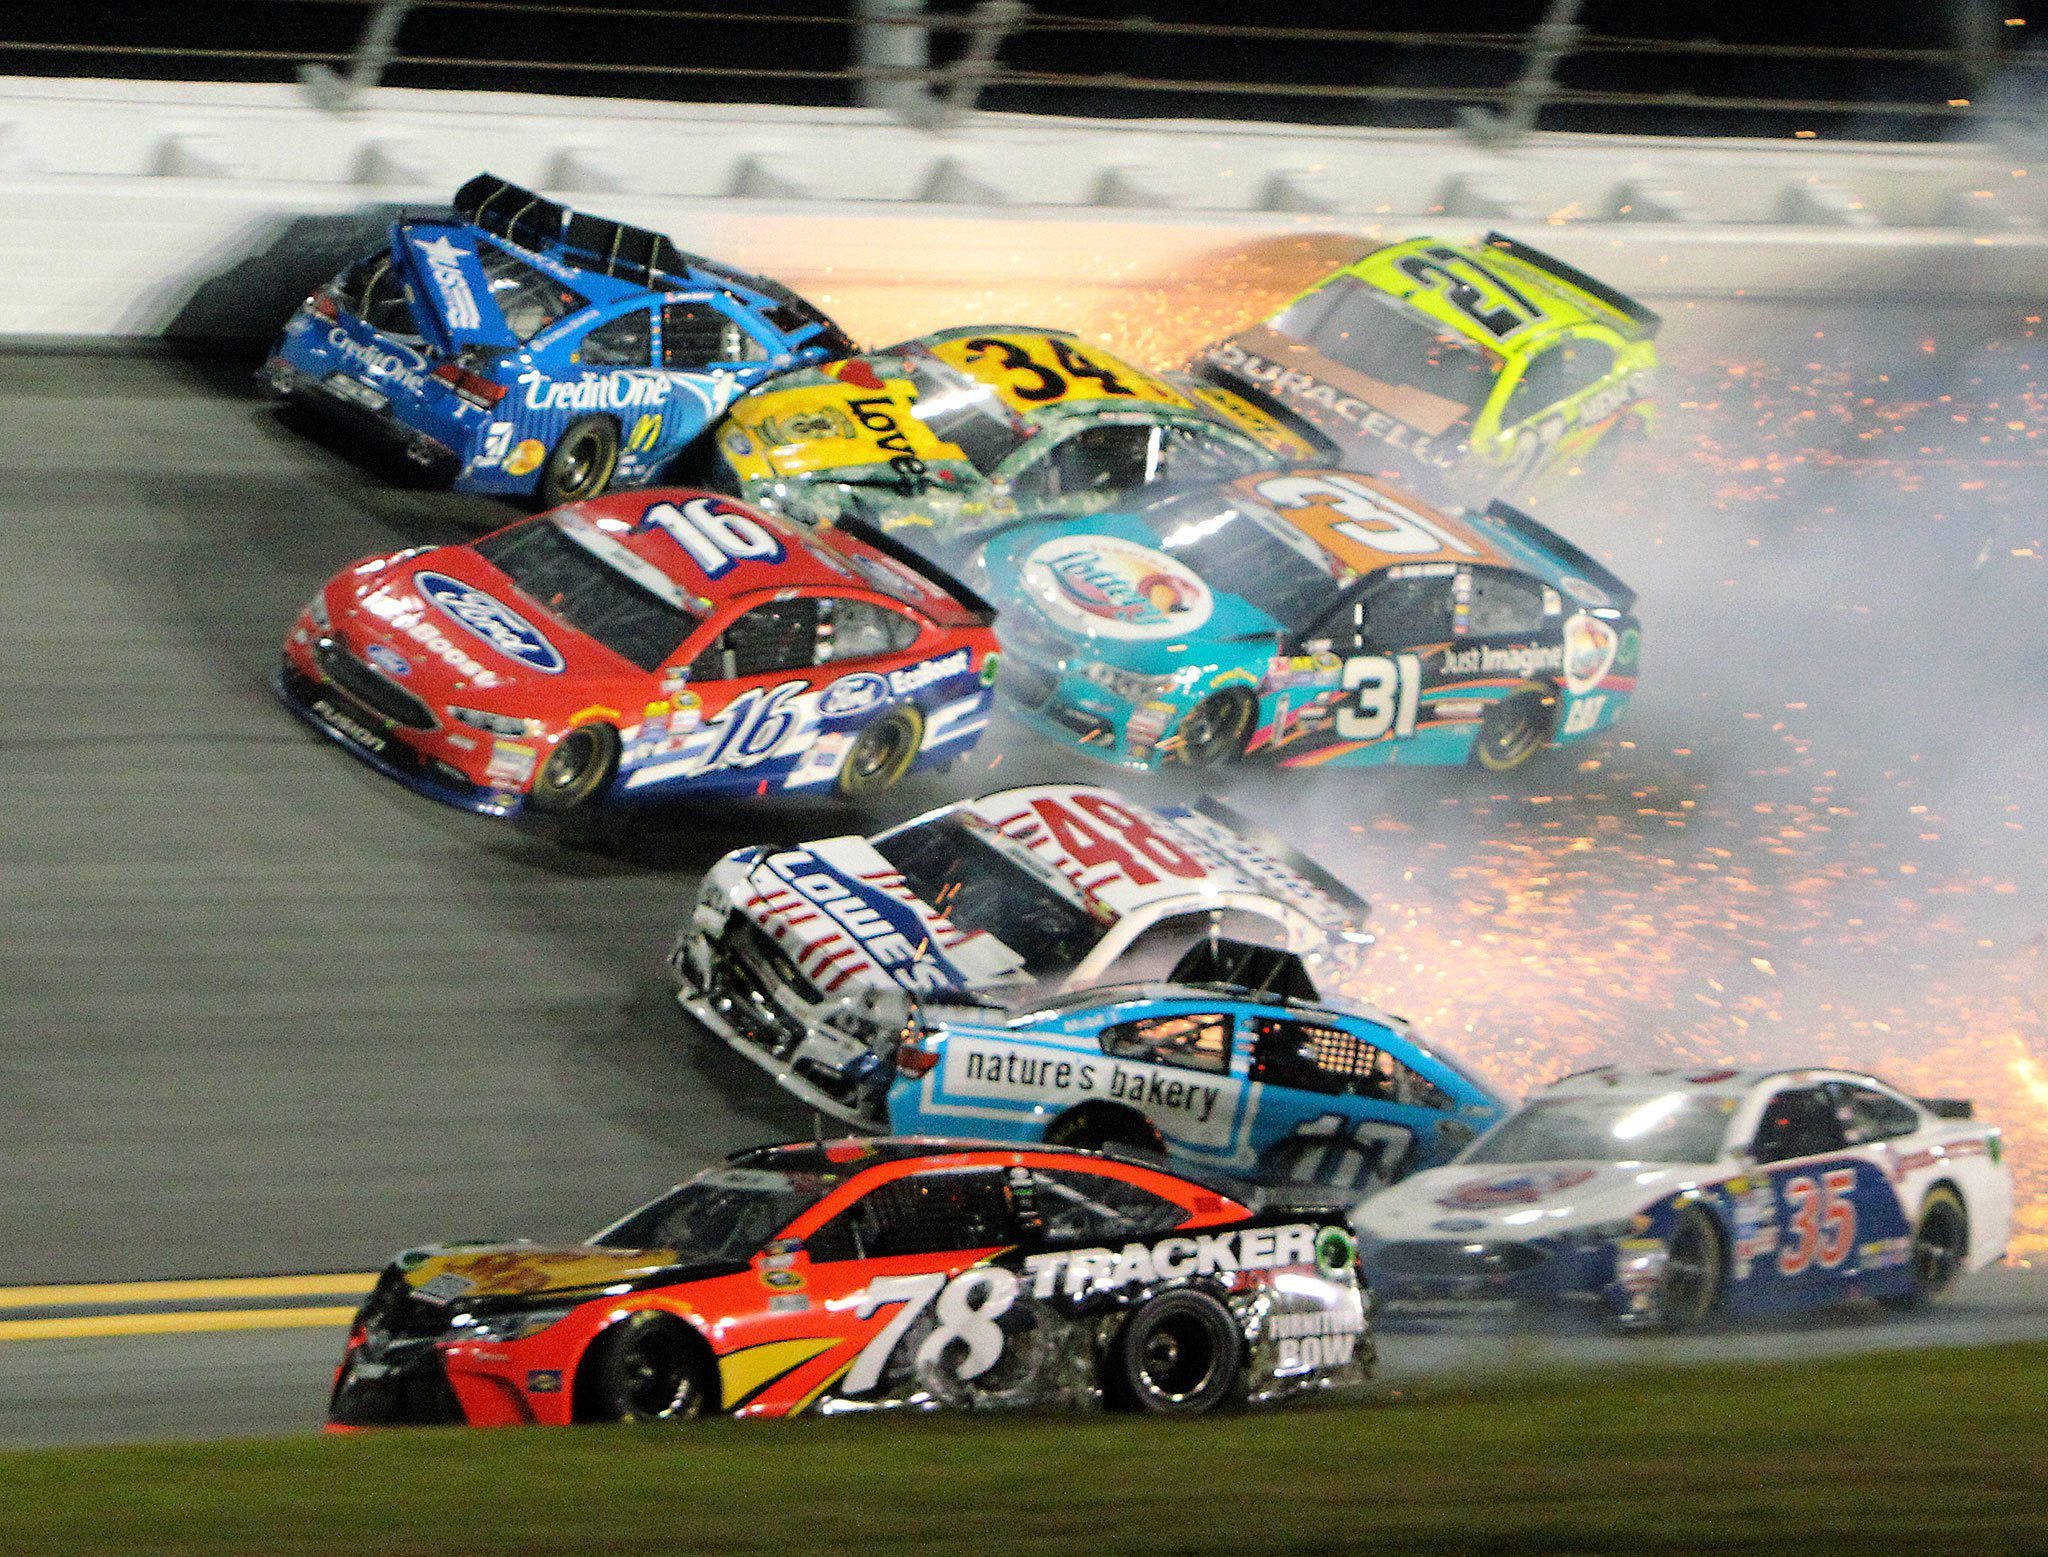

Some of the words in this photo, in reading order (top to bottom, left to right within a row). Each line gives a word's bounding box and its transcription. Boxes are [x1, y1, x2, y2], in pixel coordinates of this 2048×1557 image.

[518, 368, 673, 410] CreditOne
[964, 338, 1135, 402] 34
[642, 497, 788, 578] 16
[1255, 474, 1480, 556] 31
[432, 590, 546, 654] Ford
[1439, 645, 1481, 675] Just
[1481, 641, 1563, 676] Imagine
[688, 679, 811, 777] 16
[1336, 653, 1422, 740] 31
[1030, 795, 1207, 886] 48
[1111, 1066, 1220, 1123] bakery
[1024, 1224, 1317, 1299] TRACKER
[1778, 1167, 1857, 1276] 35
[842, 1266, 1019, 1394] 78
